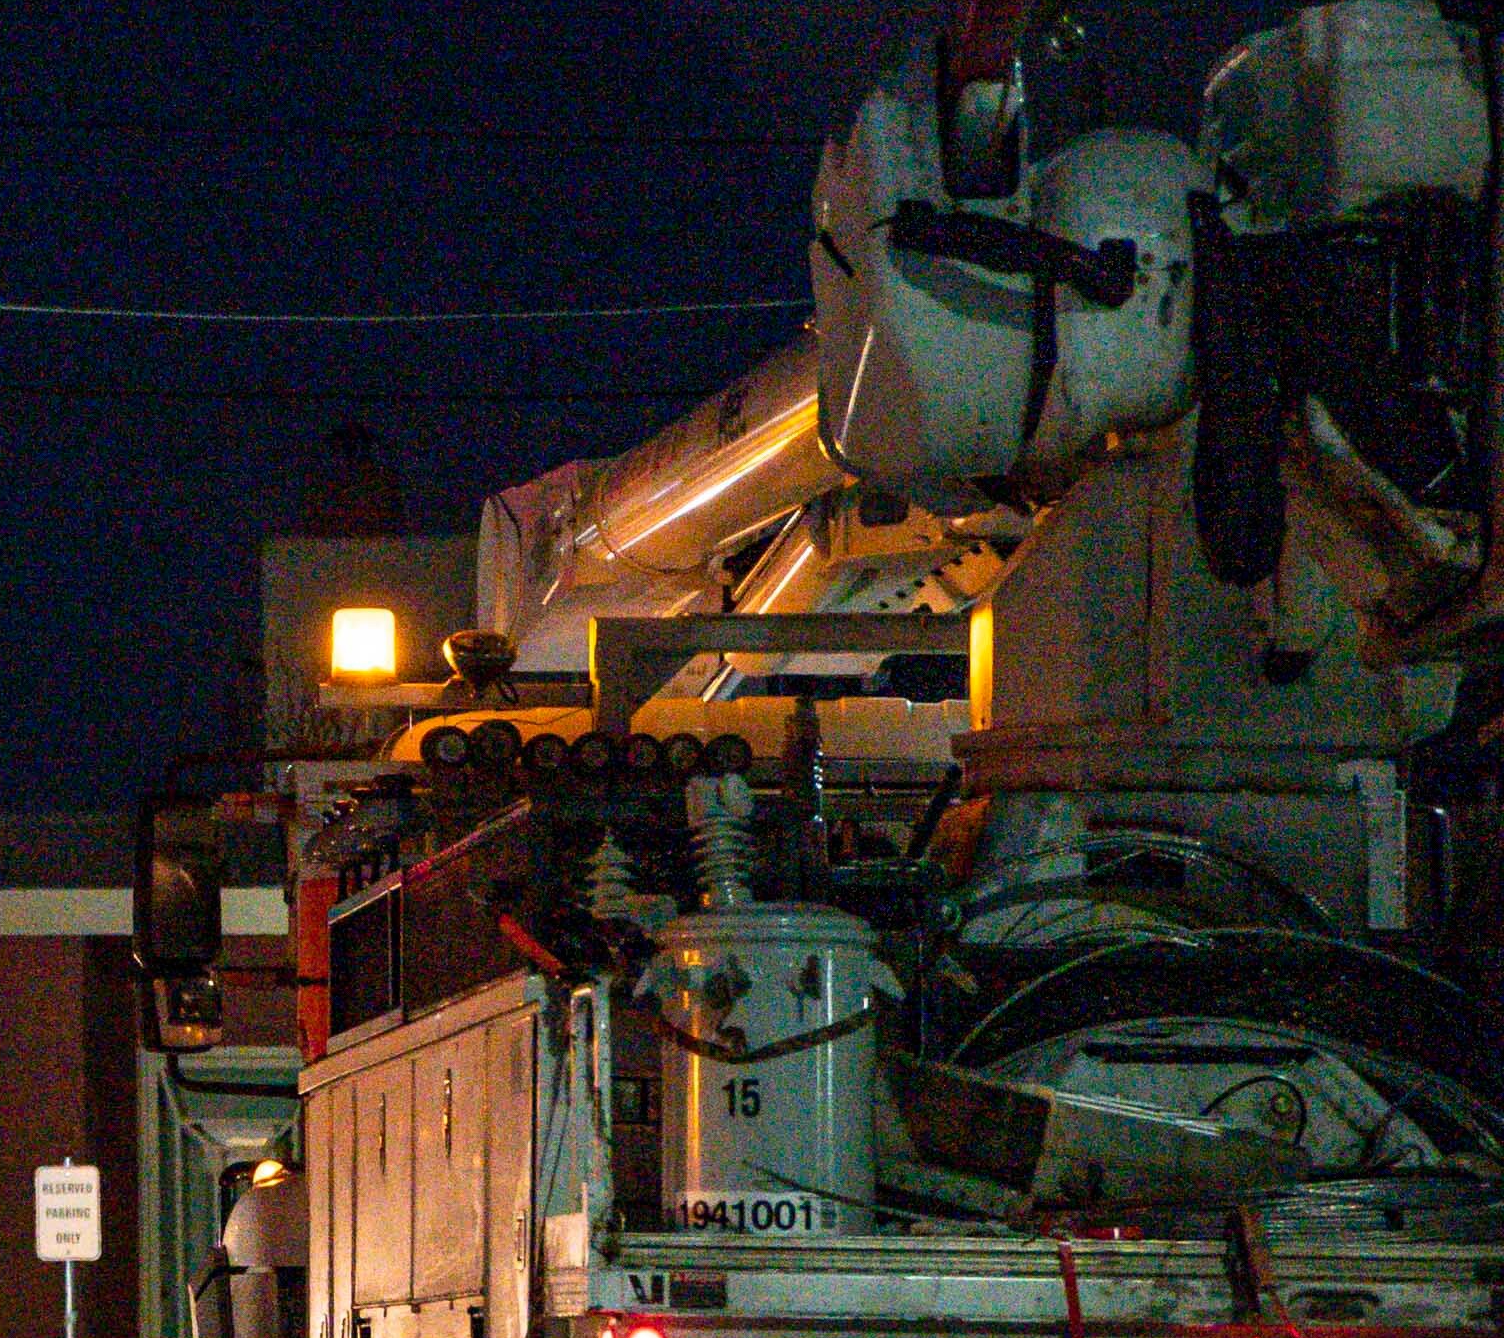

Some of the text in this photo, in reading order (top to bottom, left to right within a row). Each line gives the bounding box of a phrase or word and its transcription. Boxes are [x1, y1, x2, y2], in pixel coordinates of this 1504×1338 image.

[723, 1078, 761, 1117] 15
[42, 1182, 93, 1195] RESERVED
[45, 1207, 91, 1219] PARKING
[679, 1198, 813, 1233] 1941001
[55, 1232, 81, 1244] ONLY
